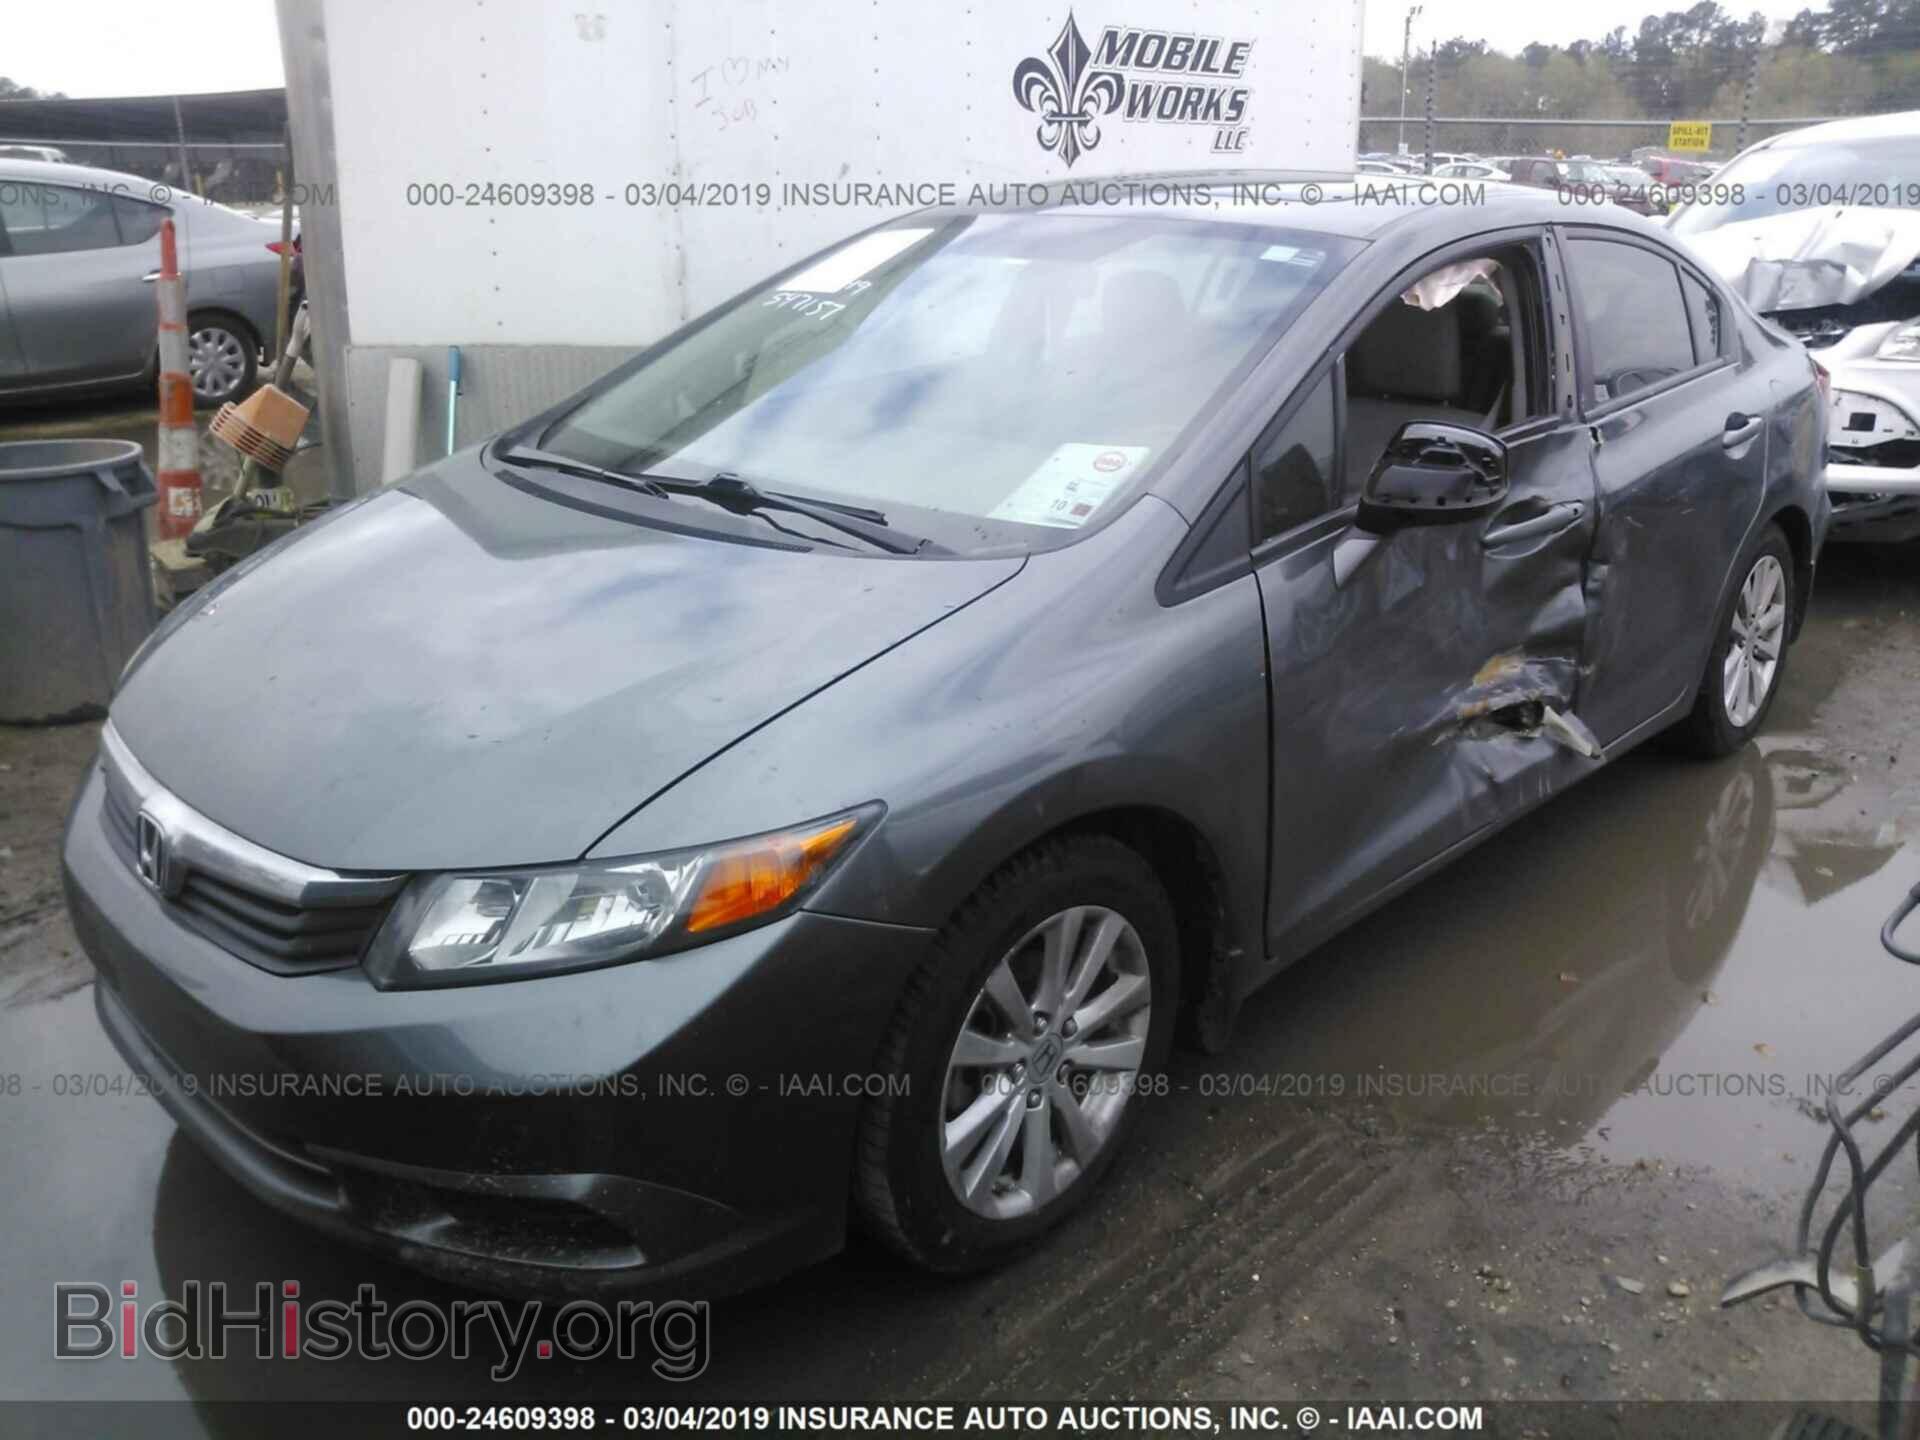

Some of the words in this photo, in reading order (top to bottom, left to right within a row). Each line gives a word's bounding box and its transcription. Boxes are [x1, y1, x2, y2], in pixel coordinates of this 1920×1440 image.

[1091, 27, 1250, 76] MOBILE
[1124, 82, 1249, 122] WORKS
[1212, 129, 1248, 151] LLC
